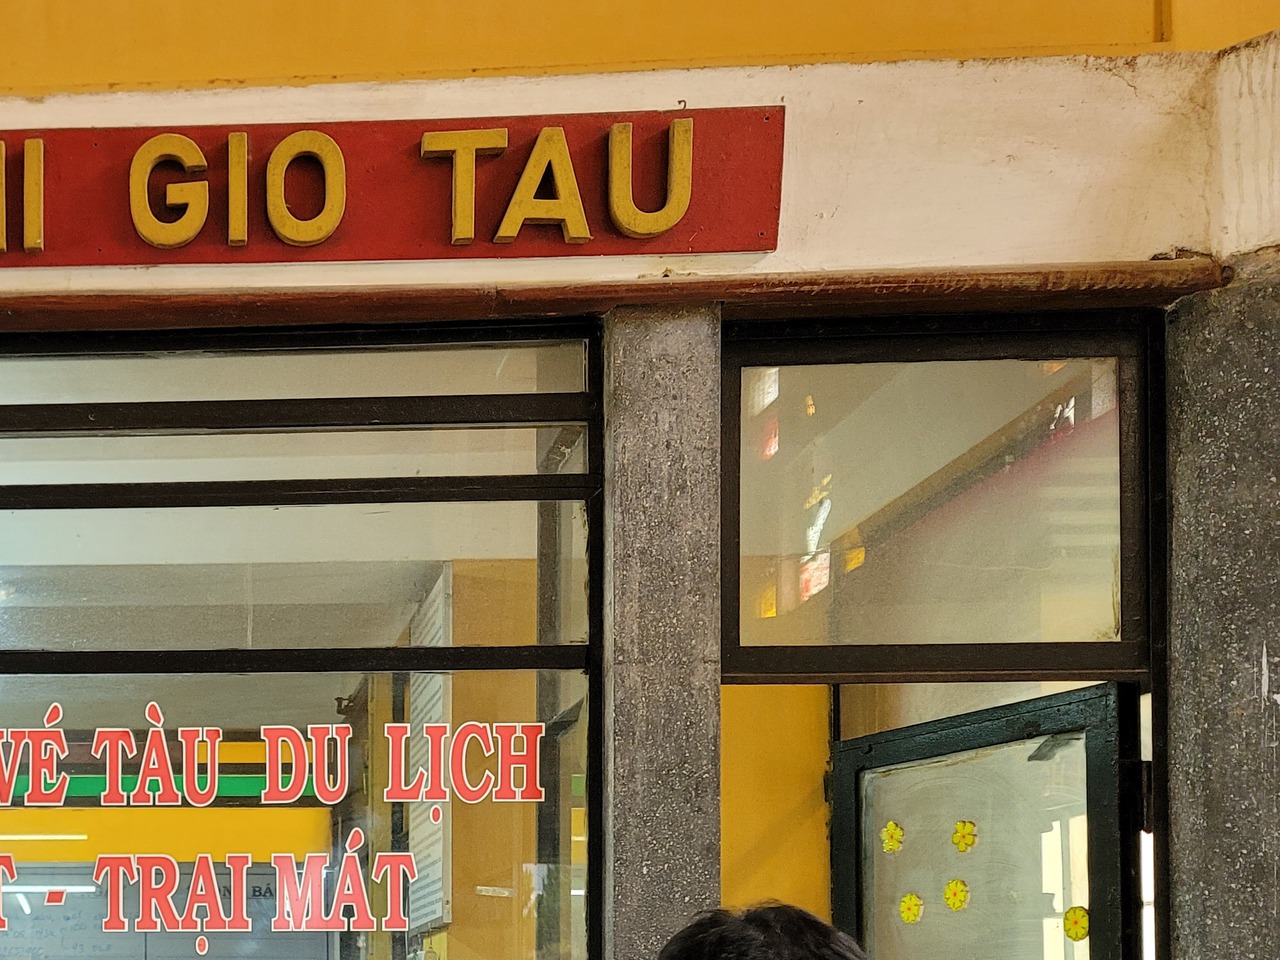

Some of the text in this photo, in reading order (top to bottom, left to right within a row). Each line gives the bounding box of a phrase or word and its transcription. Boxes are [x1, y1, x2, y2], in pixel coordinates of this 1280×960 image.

[128, 130, 347, 249] GIO
[421, 118, 694, 246] TAU
[91, 701, 223, 807] TÀU
[260, 724, 353, 805] DU
[384, 722, 546, 825] LỊCH
[93, 853, 253, 956] TRẠI
[271, 827, 418, 932] MÁT
